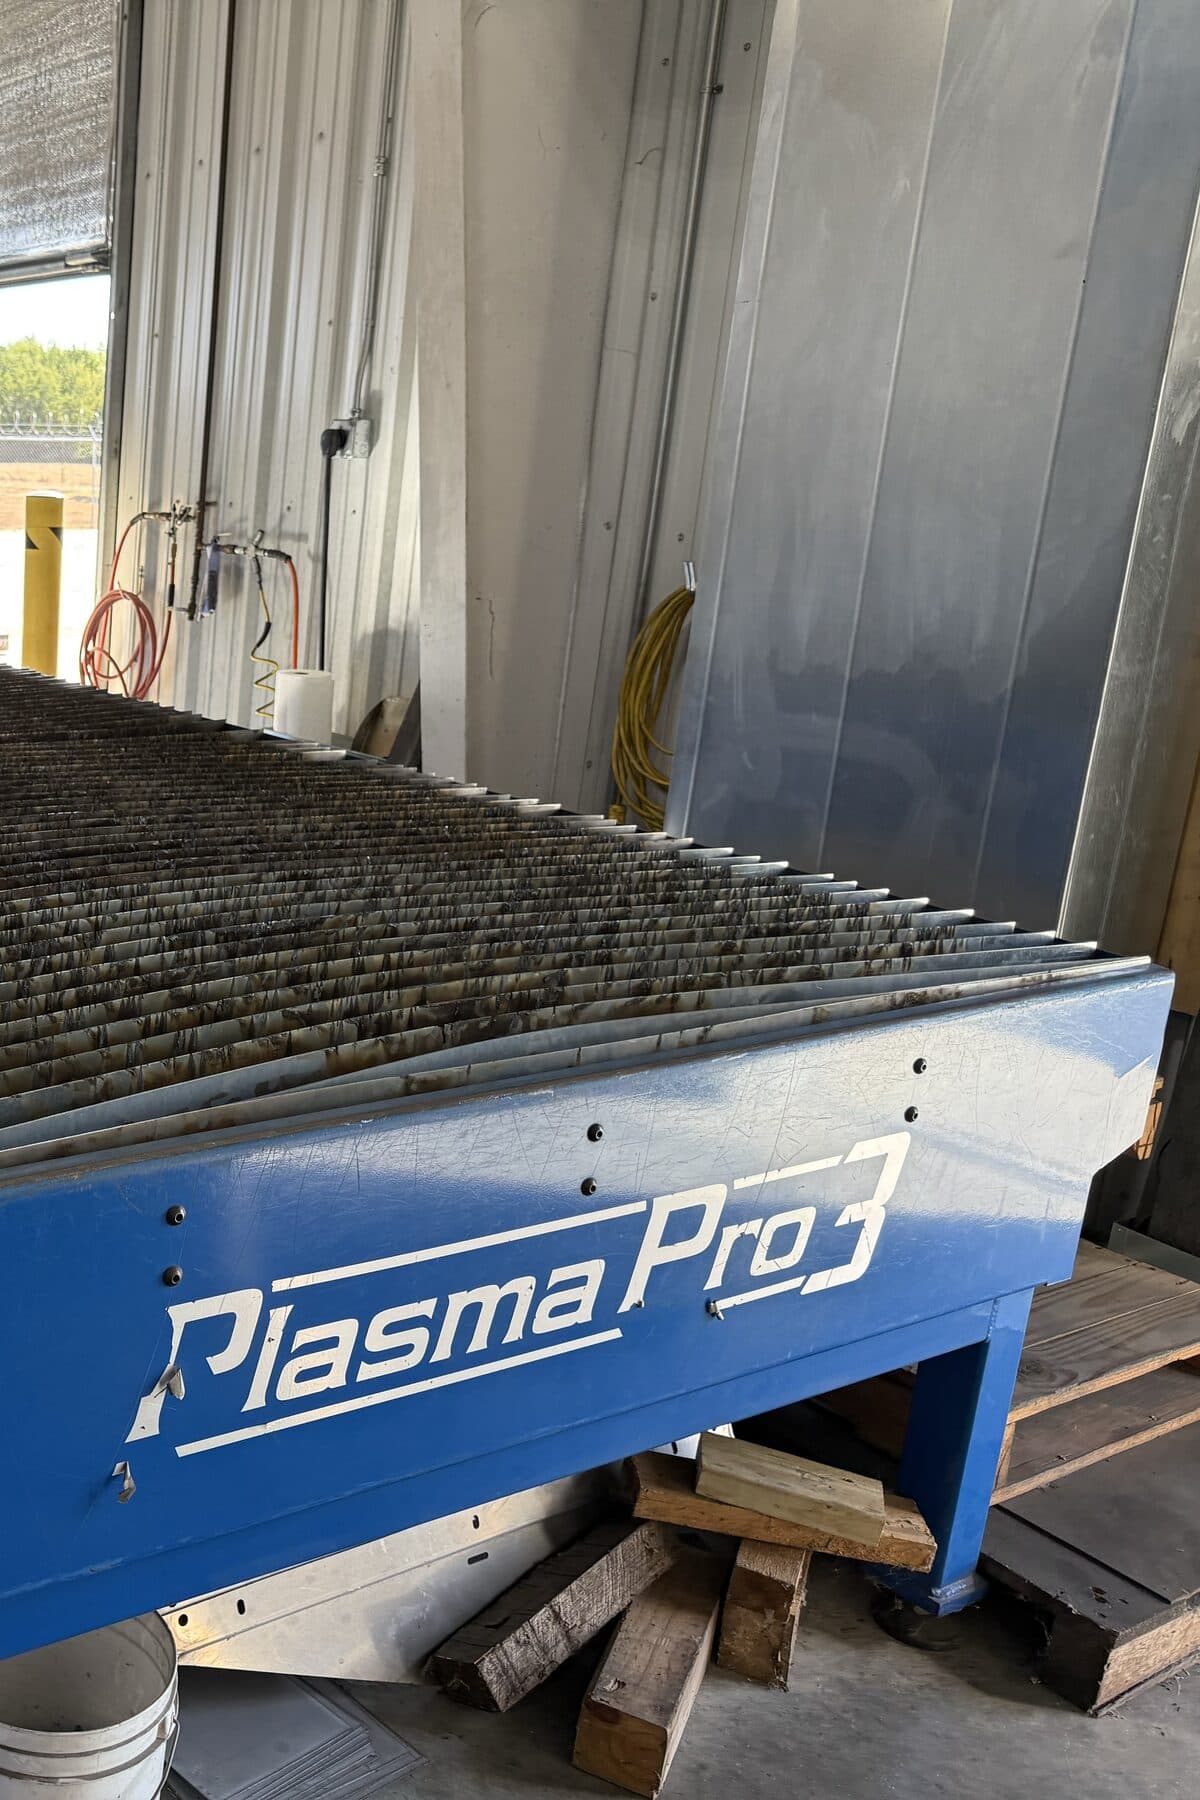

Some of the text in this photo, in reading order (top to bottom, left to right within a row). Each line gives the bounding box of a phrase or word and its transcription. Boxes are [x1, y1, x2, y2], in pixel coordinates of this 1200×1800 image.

[125, 1131, 911, 1443] Plasma Pro 3
